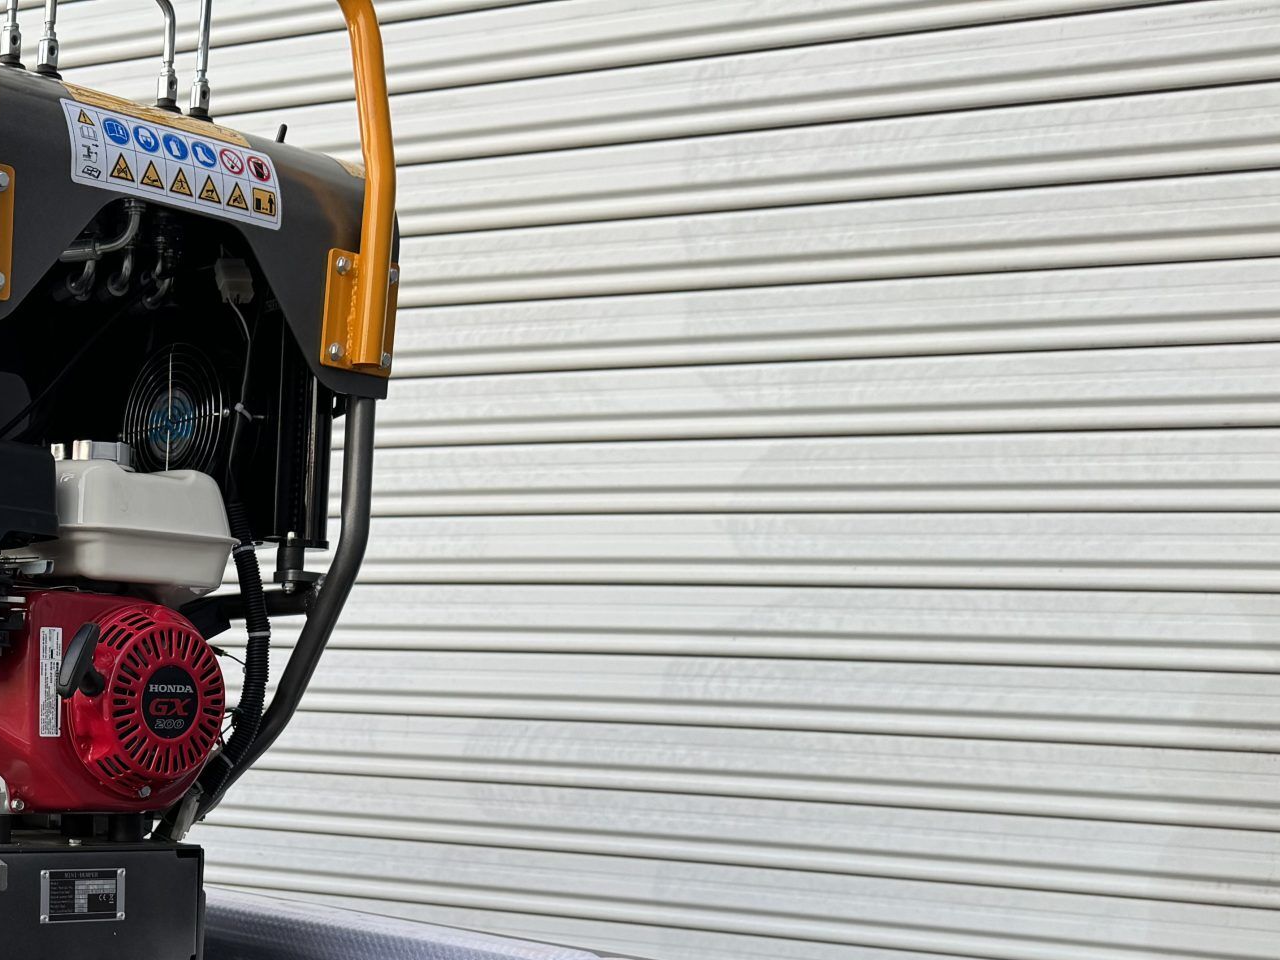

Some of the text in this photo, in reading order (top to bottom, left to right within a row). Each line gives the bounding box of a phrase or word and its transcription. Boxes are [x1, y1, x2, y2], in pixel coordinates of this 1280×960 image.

[149, 684, 194, 693] HONDA
[149, 698, 192, 716] GX
[154, 719, 185, 729] 200
